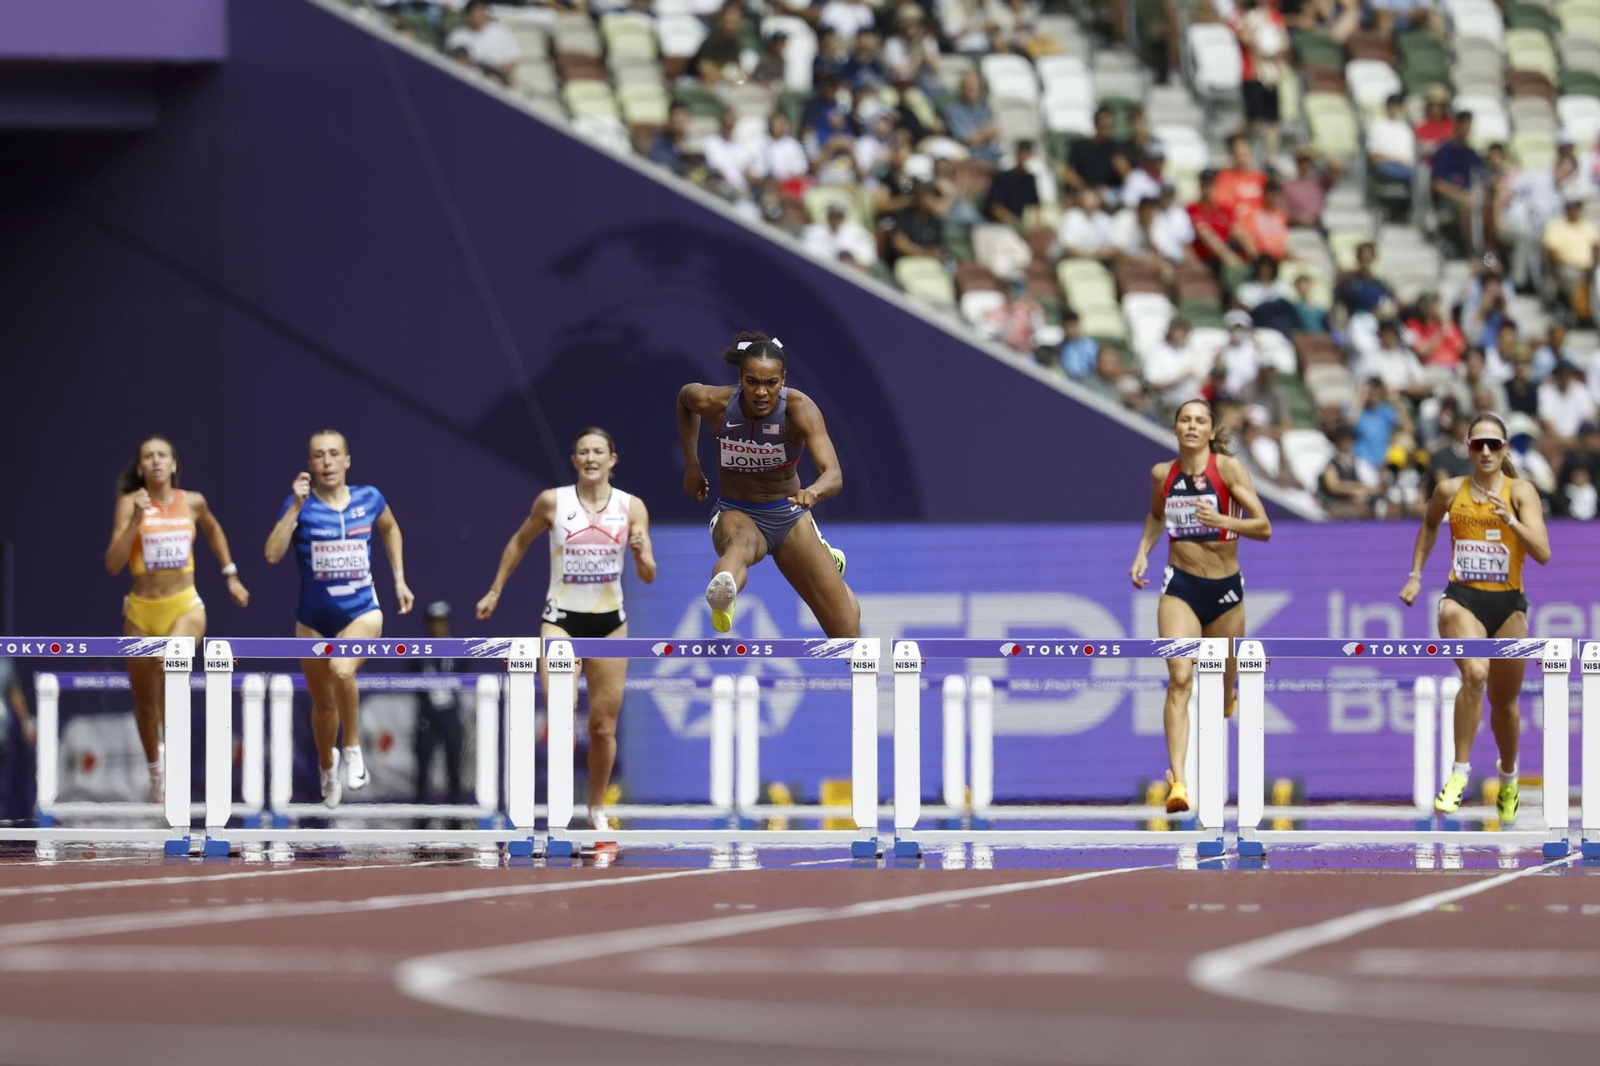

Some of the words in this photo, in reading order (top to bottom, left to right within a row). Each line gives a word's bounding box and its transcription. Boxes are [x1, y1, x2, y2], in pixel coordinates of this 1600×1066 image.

[721, 442, 783, 455] HONDA
[725, 456, 783, 467] JONES
[1167, 498, 1214, 509] HONA
[157, 547, 183, 558] FRA
[314, 543, 365, 553] HONDA
[565, 548, 618, 556] HONDA
[1456, 543, 1508, 555] HONDA
[316, 556, 366, 569] HALONEN
[1456, 556, 1506, 571] KELETY
[0, 643, 88, 656] OKYO25
[165, 660, 189, 668] NISHI
[207, 660, 230, 669] NISHI
[510, 661, 533, 669] NISHI
[549, 661, 572, 669] NISHI
[853, 661, 876, 670] NISHI
[895, 661, 918, 669] NISHI
[1199, 661, 1222, 669] NISHI
[1239, 661, 1262, 669] NISHI
